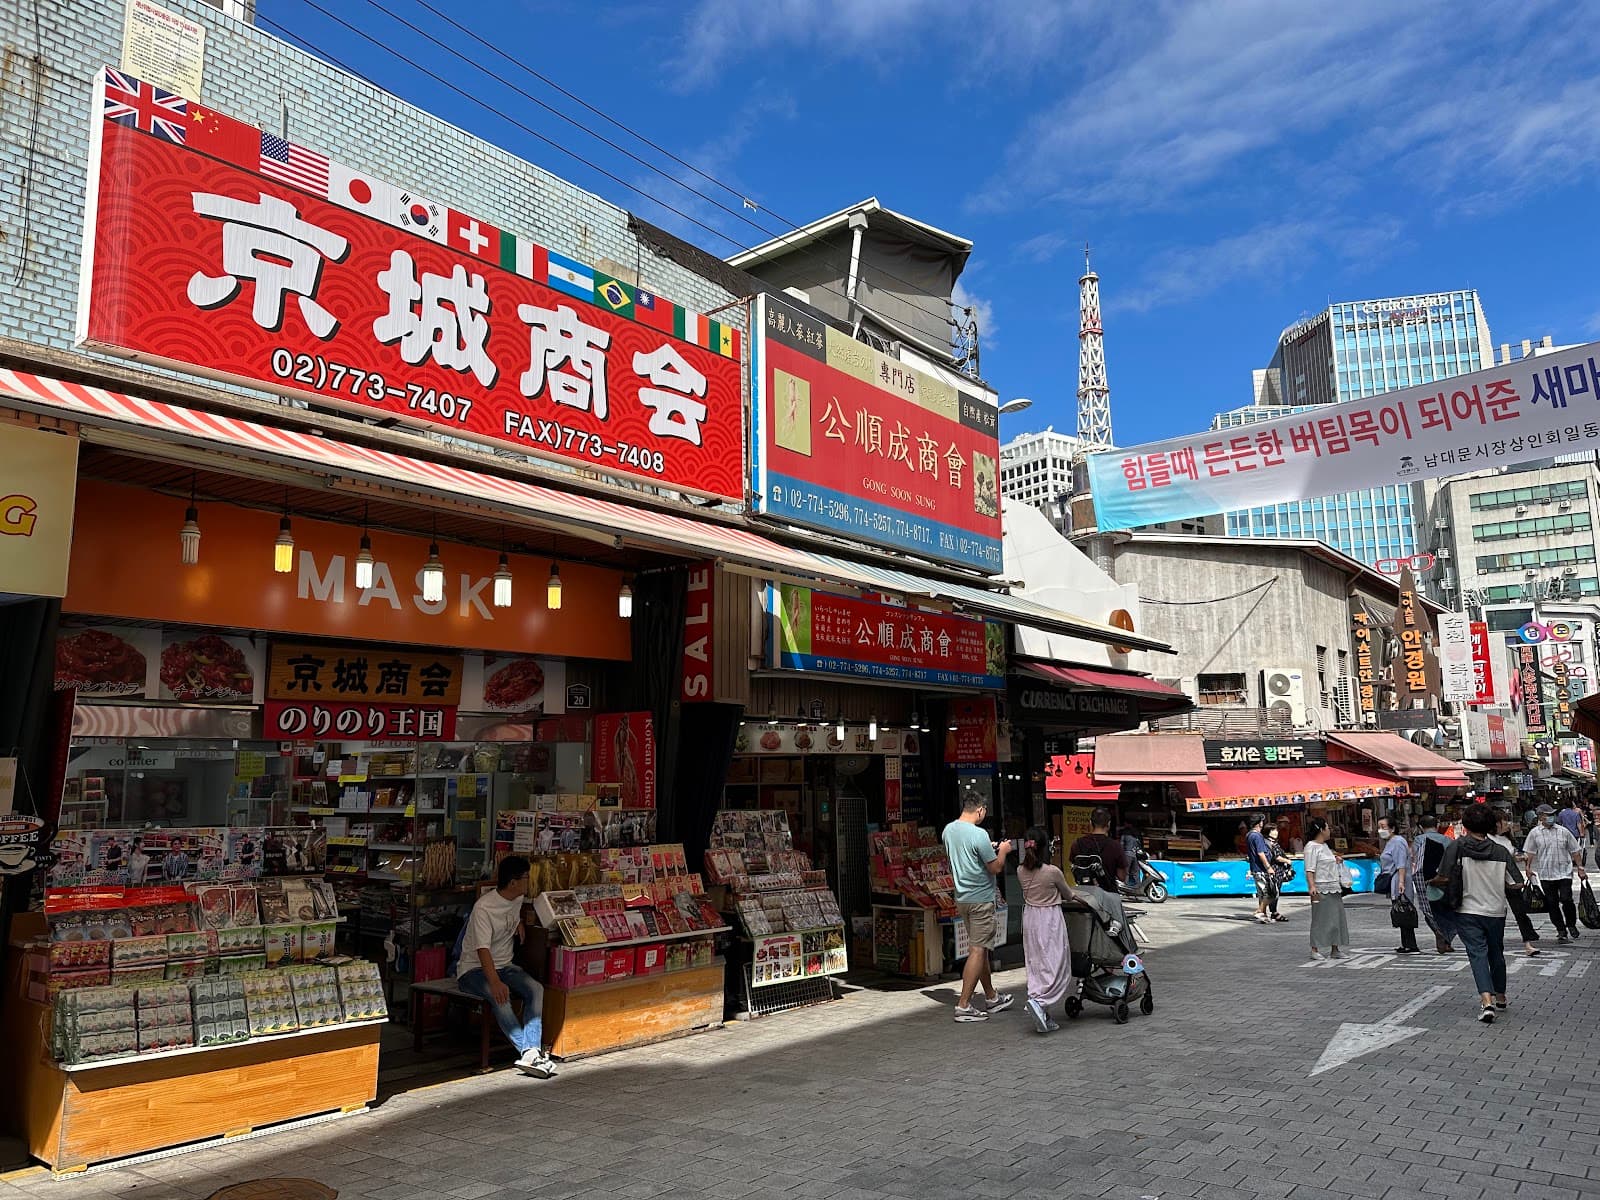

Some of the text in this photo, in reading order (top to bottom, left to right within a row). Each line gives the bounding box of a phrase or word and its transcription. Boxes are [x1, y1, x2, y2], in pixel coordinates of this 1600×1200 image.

[187, 191, 707, 446] 京城商会
[1363, 296, 1448, 313] COURTYARD
[271, 349, 473, 423] 02)773-7407
[504, 411, 664, 473] FAX)773-7408
[819, 396, 967, 490] 公順成商會
[1121, 450, 1199, 492] 힘들때
[1202, 429, 1284, 476] 든든한
[1289, 402, 1412, 458] 버팀목이
[1419, 378, 1521, 431] 되어준
[862, 477, 936, 511] GONG SOON SUNG
[297, 550, 494, 620] MASK
[684, 567, 709, 698] SALE
[855, 617, 953, 658] 公順成商會
[287, 654, 451, 696] 京城商会
[1400, 629, 1427, 691] 안경원
[174, 685, 243, 699] チャンジャ
[573, 695, 584, 705] 20
[1020, 690, 1128, 714] CURRENCY EXCHANGE
[279, 706, 444, 737] のりのり王国
[644, 718, 654, 766] Korean
[1220, 746, 1304, 762] 효자손 왕만두
[0, 831, 39, 845] FFEE
